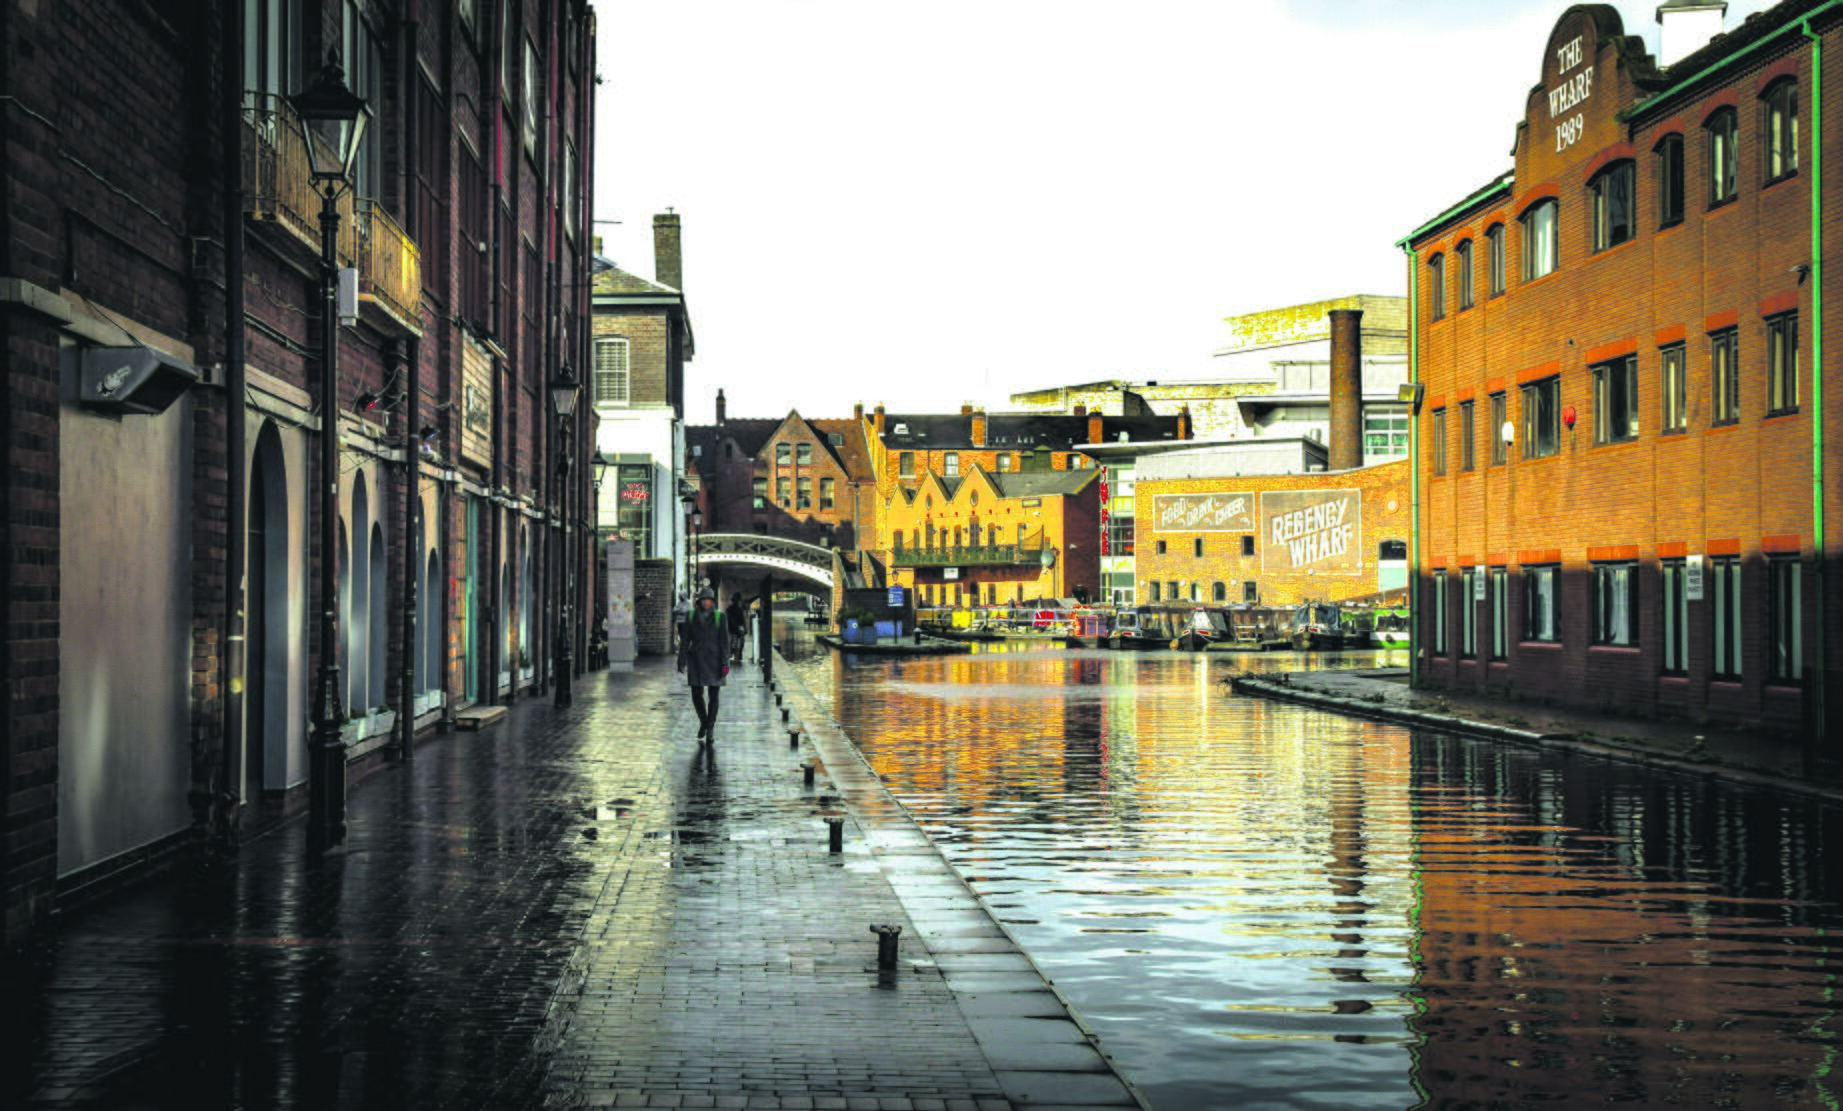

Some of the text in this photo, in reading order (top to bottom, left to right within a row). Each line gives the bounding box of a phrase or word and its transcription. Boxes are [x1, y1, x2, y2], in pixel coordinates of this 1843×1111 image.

[1557, 35, 1583, 75] THE
[1549, 66, 1593, 118] WHARF
[1556, 113, 1584, 152] 1989
[1162, 497, 1186, 528] FOOD
[1271, 497, 1348, 545] REGENCY
[1288, 522, 1353, 569] WHARF
